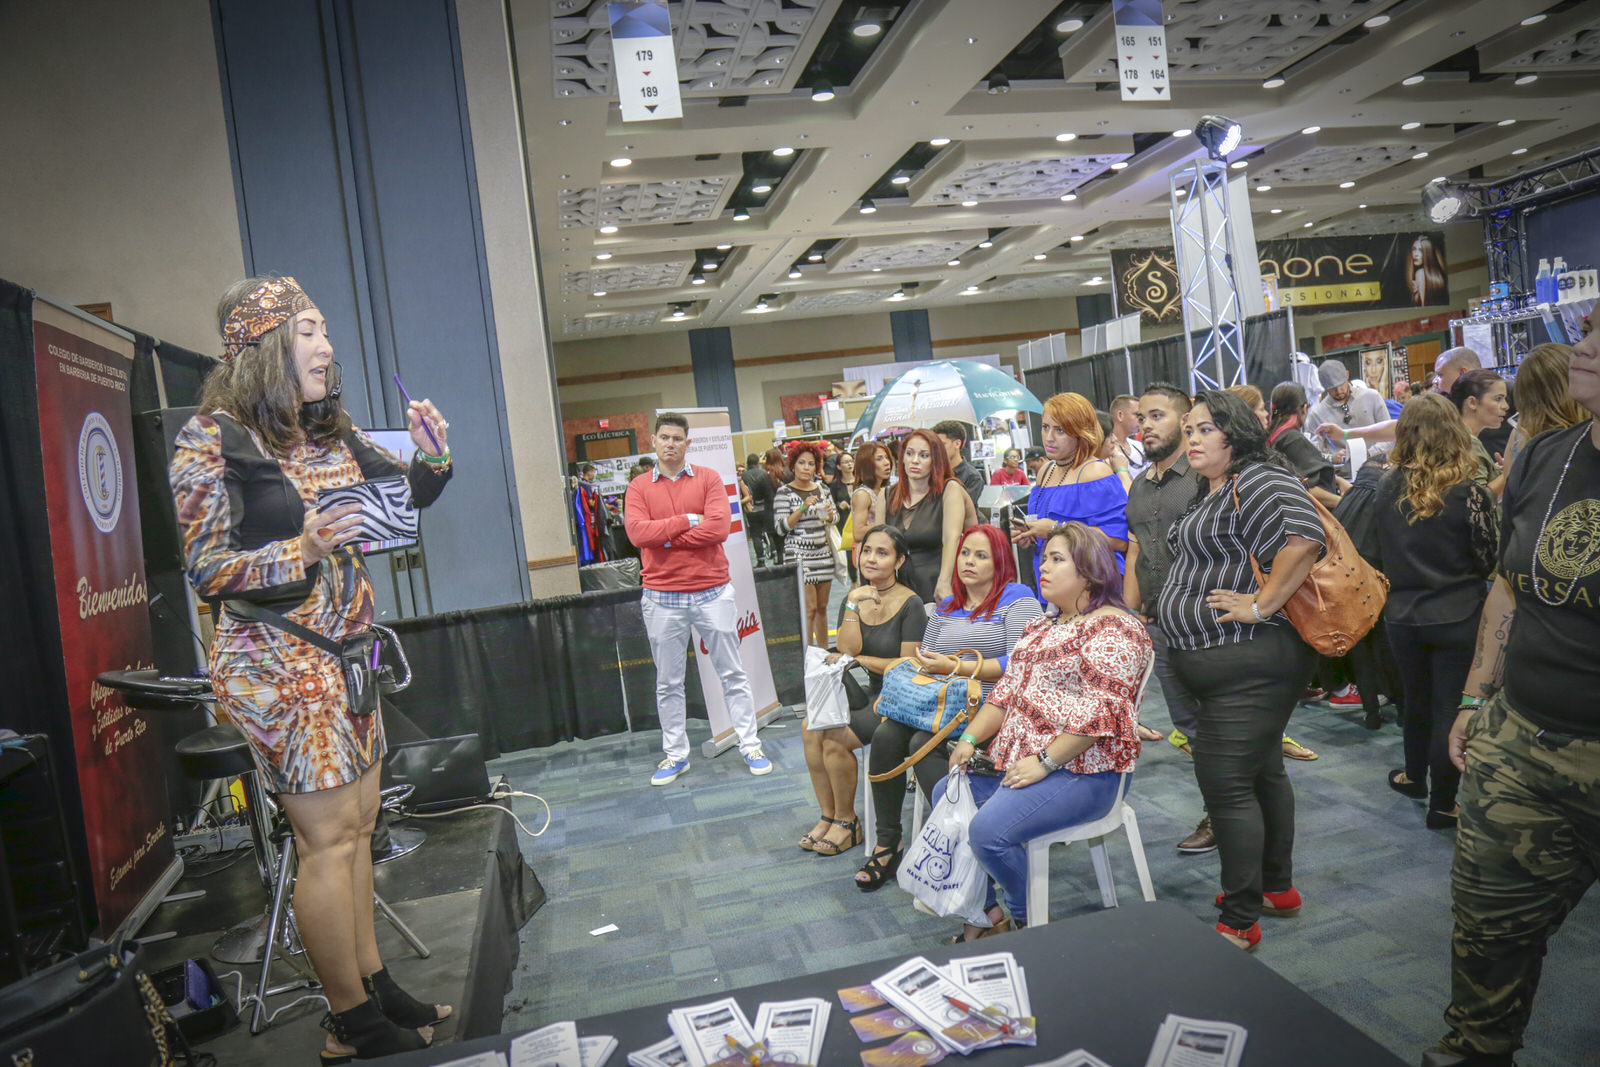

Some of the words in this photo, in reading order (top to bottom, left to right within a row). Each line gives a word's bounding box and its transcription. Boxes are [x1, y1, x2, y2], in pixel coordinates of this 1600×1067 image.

[1121, 36, 1136, 47] 165
[1148, 36, 1162, 47] 151
[636, 50, 653, 61] 179
[1124, 69, 1139, 80] 178
[1151, 69, 1165, 80] 164
[641, 86, 658, 98] 189
[1284, 288, 1376, 303] SSIONAL
[582, 433, 597, 441] ECO
[1506, 570, 1600, 608] VERSA
[76, 571, 148, 620] Bienvenidos
[906, 868, 922, 882] HAVE
